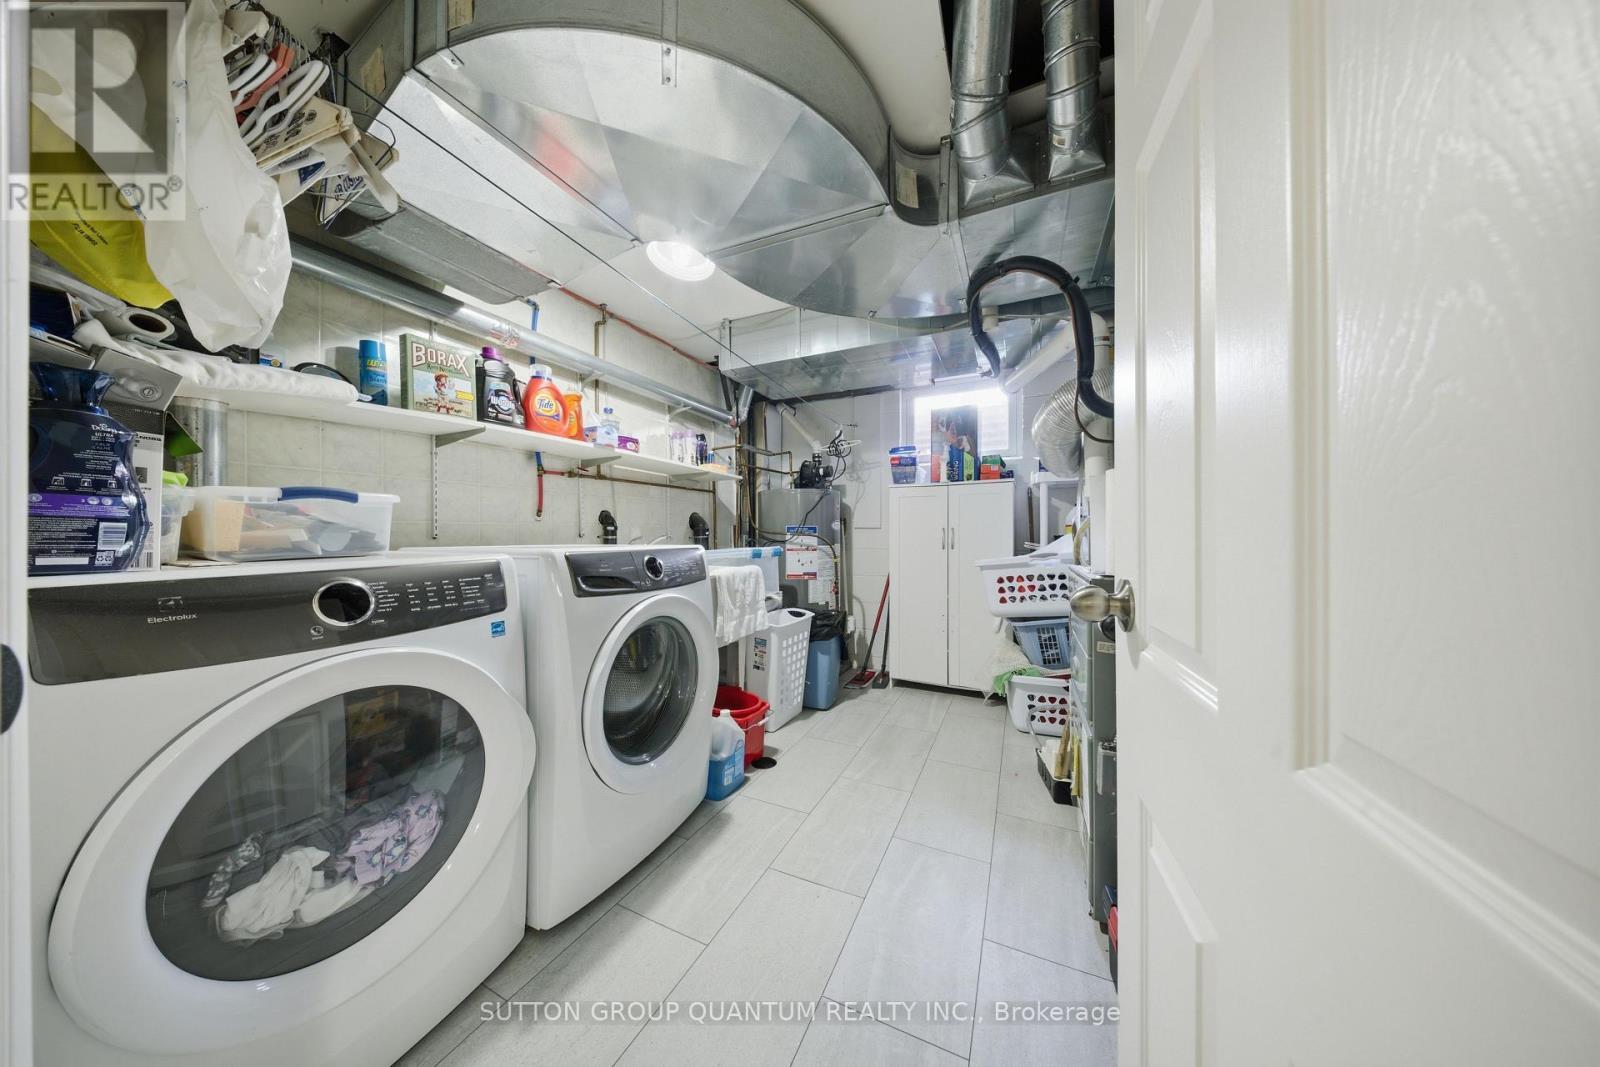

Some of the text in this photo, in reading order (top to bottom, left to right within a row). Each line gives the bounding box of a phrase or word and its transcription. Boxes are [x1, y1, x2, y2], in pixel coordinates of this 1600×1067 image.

[412, 342, 471, 378] BORAX
[537, 397, 554, 410] Tide
[147, 612, 198, 624] Electrolux
